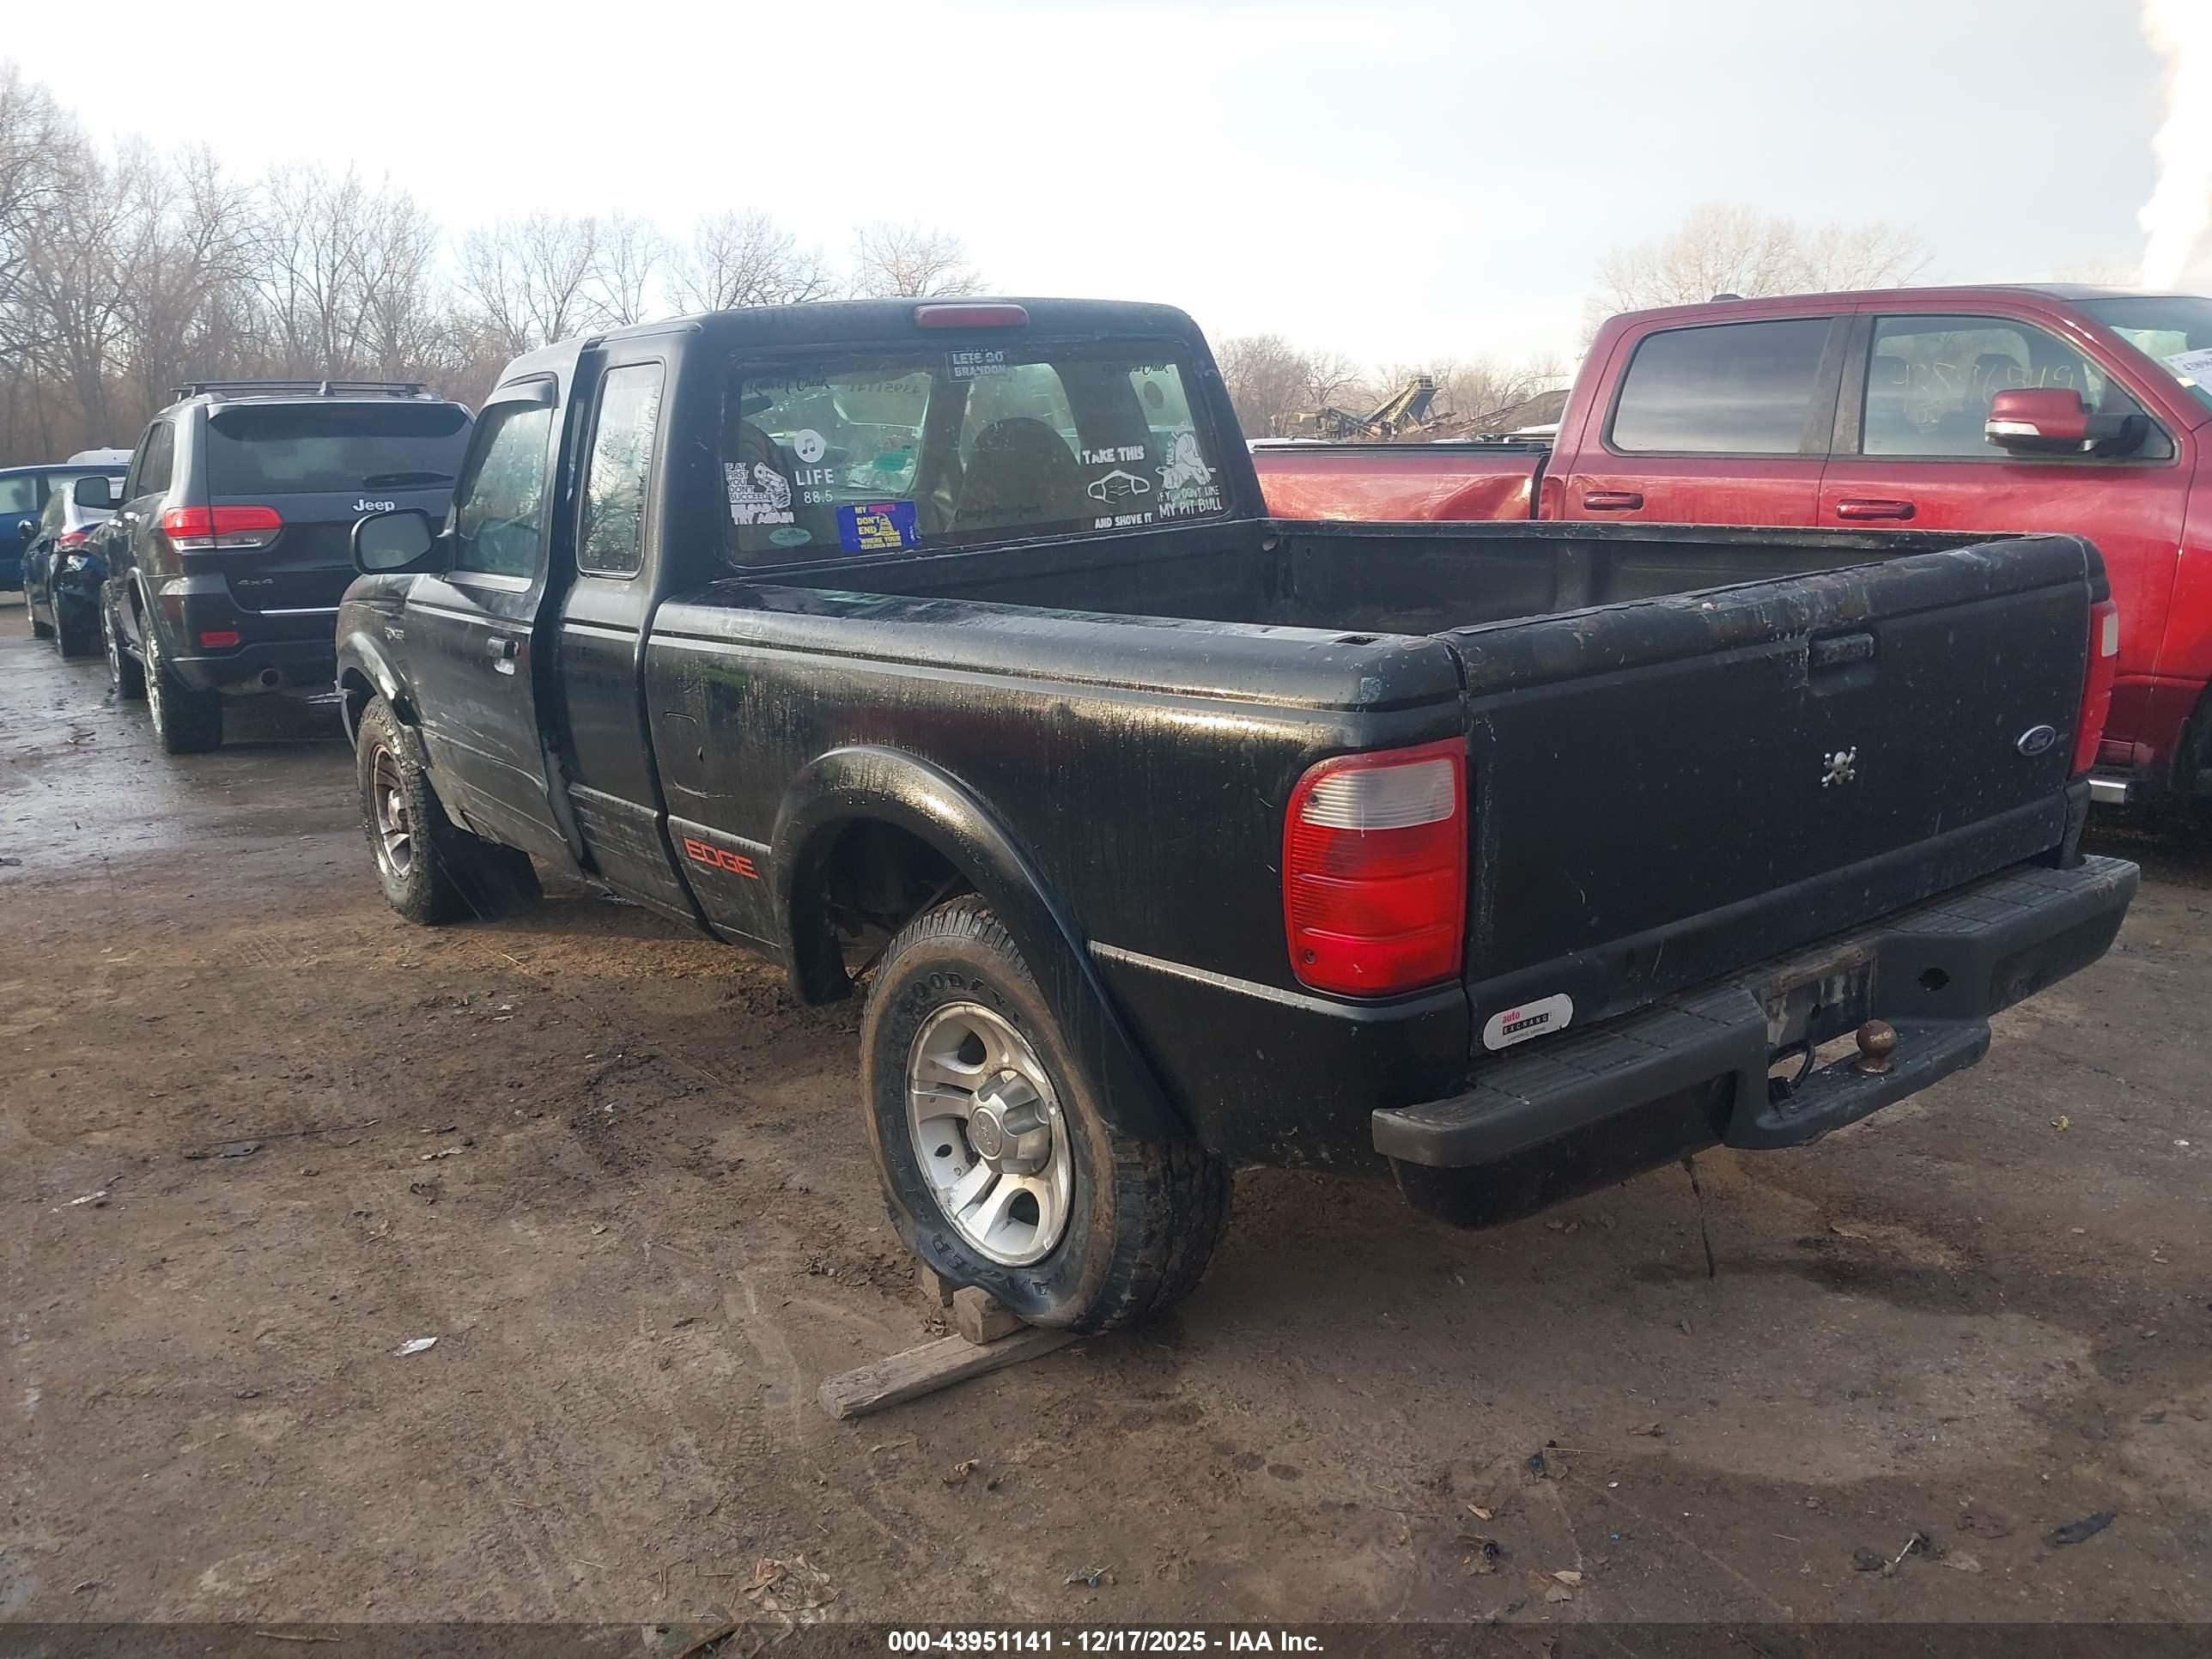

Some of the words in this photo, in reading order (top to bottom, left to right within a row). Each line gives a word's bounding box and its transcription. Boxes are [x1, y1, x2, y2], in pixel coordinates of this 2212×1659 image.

[986, 350, 1005, 363] GO
[954, 364, 1006, 377] BRANDON
[1083, 447, 1116, 465] TAKE
[1117, 445, 1146, 462] THIS
[795, 468, 835, 486] LIFE
[729, 493, 769, 501] SUCCEED
[804, 489, 833, 504] 88.5
[1205, 485, 1219, 496] LIKE
[352, 499, 396, 513] Jeep
[1158, 502, 1176, 519] MY
[1180, 500, 1194, 515] PIT
[1198, 497, 1223, 513] BULL
[856, 516, 880, 525] DON'T
[1095, 517, 1113, 529] AND
[1115, 514, 1143, 527] SHOVE
[1144, 512, 1153, 523] IT
[859, 526, 877, 535] END
[684, 838, 759, 880] EDGE
[1502, 1012, 1521, 1024] auto
